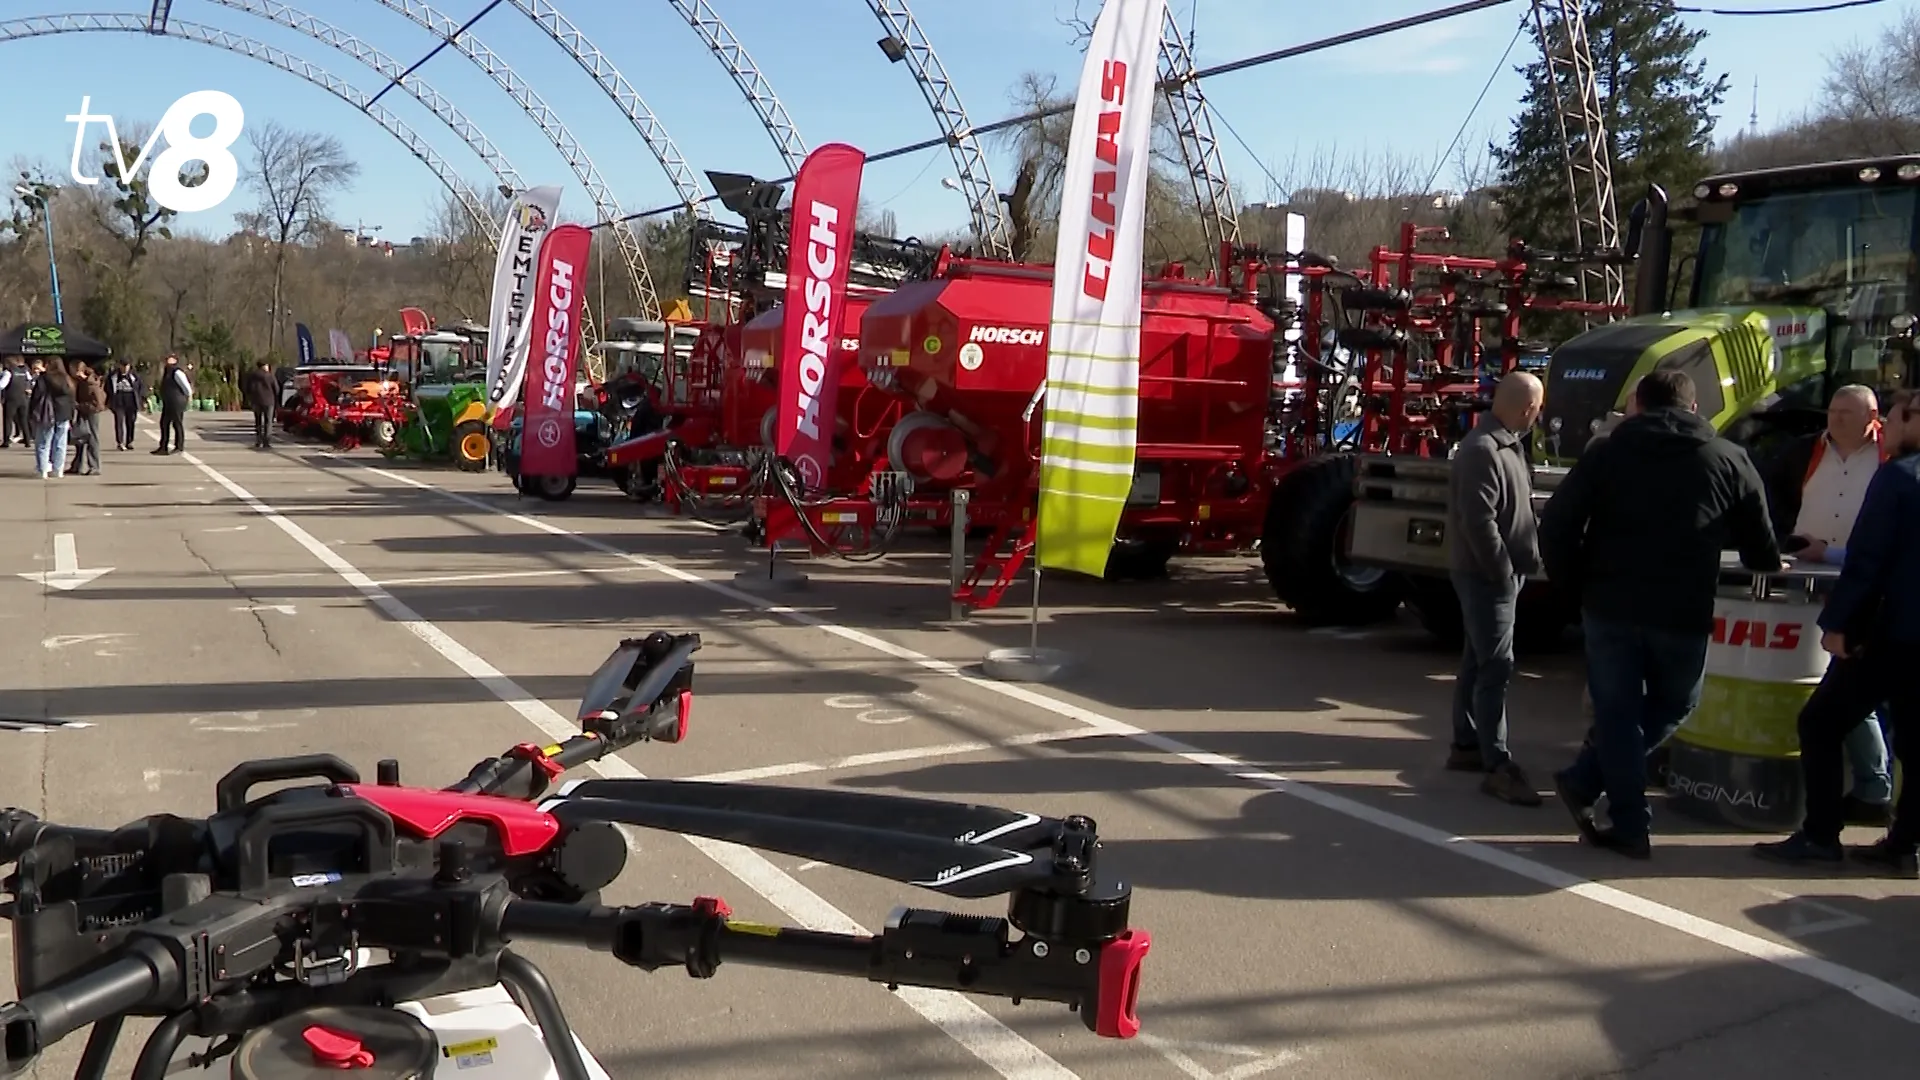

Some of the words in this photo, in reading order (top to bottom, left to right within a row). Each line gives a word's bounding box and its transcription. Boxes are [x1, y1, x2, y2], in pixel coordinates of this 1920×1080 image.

[1083, 59, 1127, 302] CLAAS
[542, 258, 574, 412] HORSCH
[796, 200, 839, 441] HORSCH
[969, 325, 1045, 346] HORSCH
[1776, 322, 1807, 337] CLAAS
[1563, 368, 1606, 381] CLAAS
[1667, 771, 1771, 810] ORIGINAL
